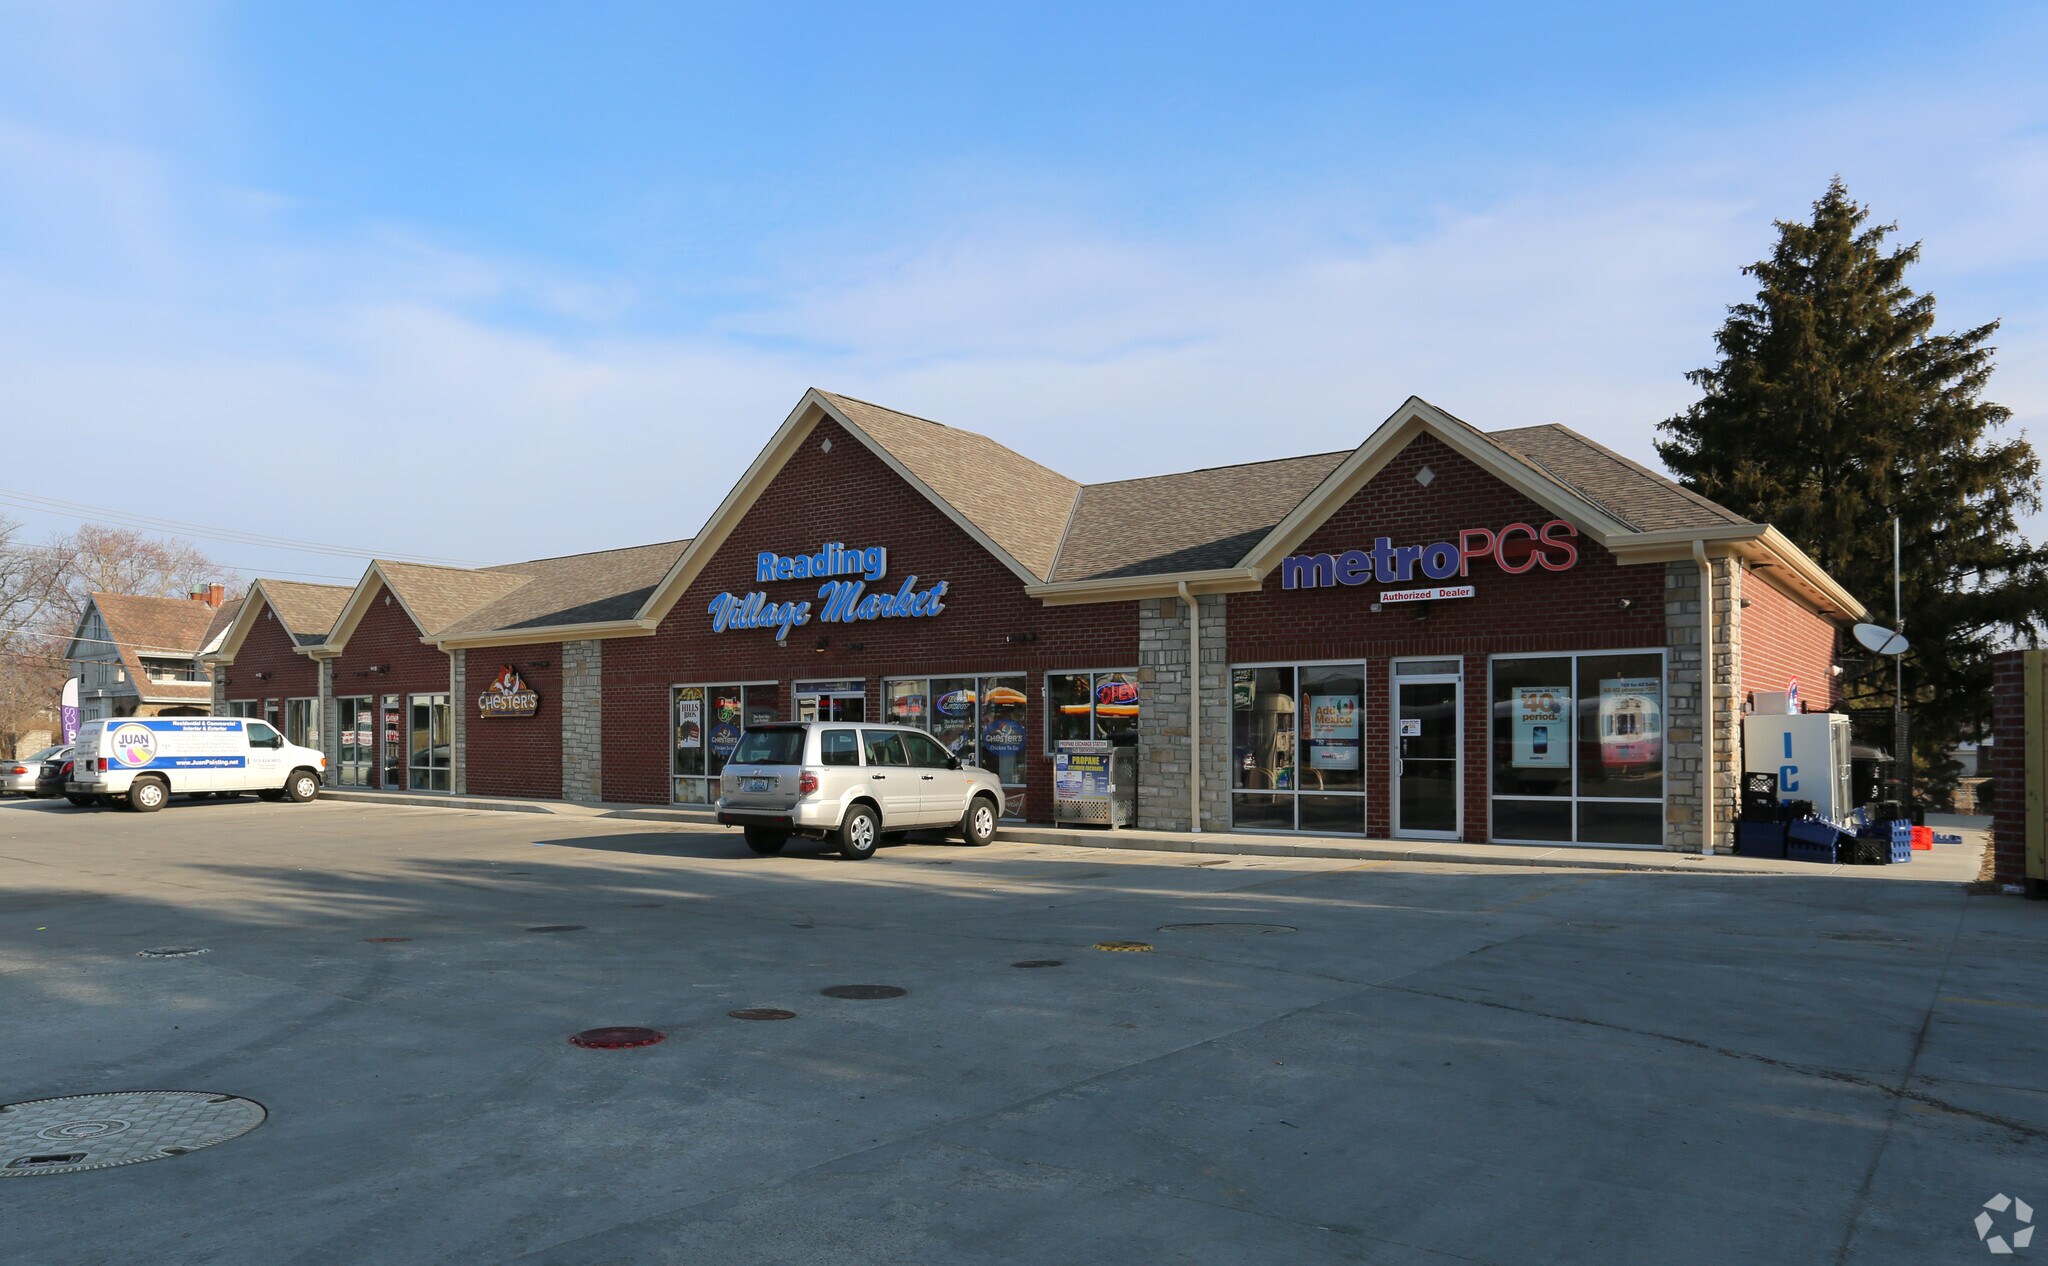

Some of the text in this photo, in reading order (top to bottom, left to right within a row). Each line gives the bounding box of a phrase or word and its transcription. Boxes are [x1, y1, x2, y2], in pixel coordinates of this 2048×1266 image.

[1282, 519, 1578, 590] metroPCS
[756, 542, 887, 582] Reading
[1383, 589, 1470, 601] Authorized Dealer
[708, 575, 949, 641] Village Market
[1101, 682, 1137, 705] OPEN
[478, 694, 537, 710] CHESTER'S
[682, 704, 699, 712] HILLS
[1315, 706, 1336, 714] Add
[1315, 714, 1352, 724] Mexico
[1523, 712, 1557, 722] period.
[118, 734, 149, 745] JUAN
[1072, 756, 1100, 765] PROPANE
